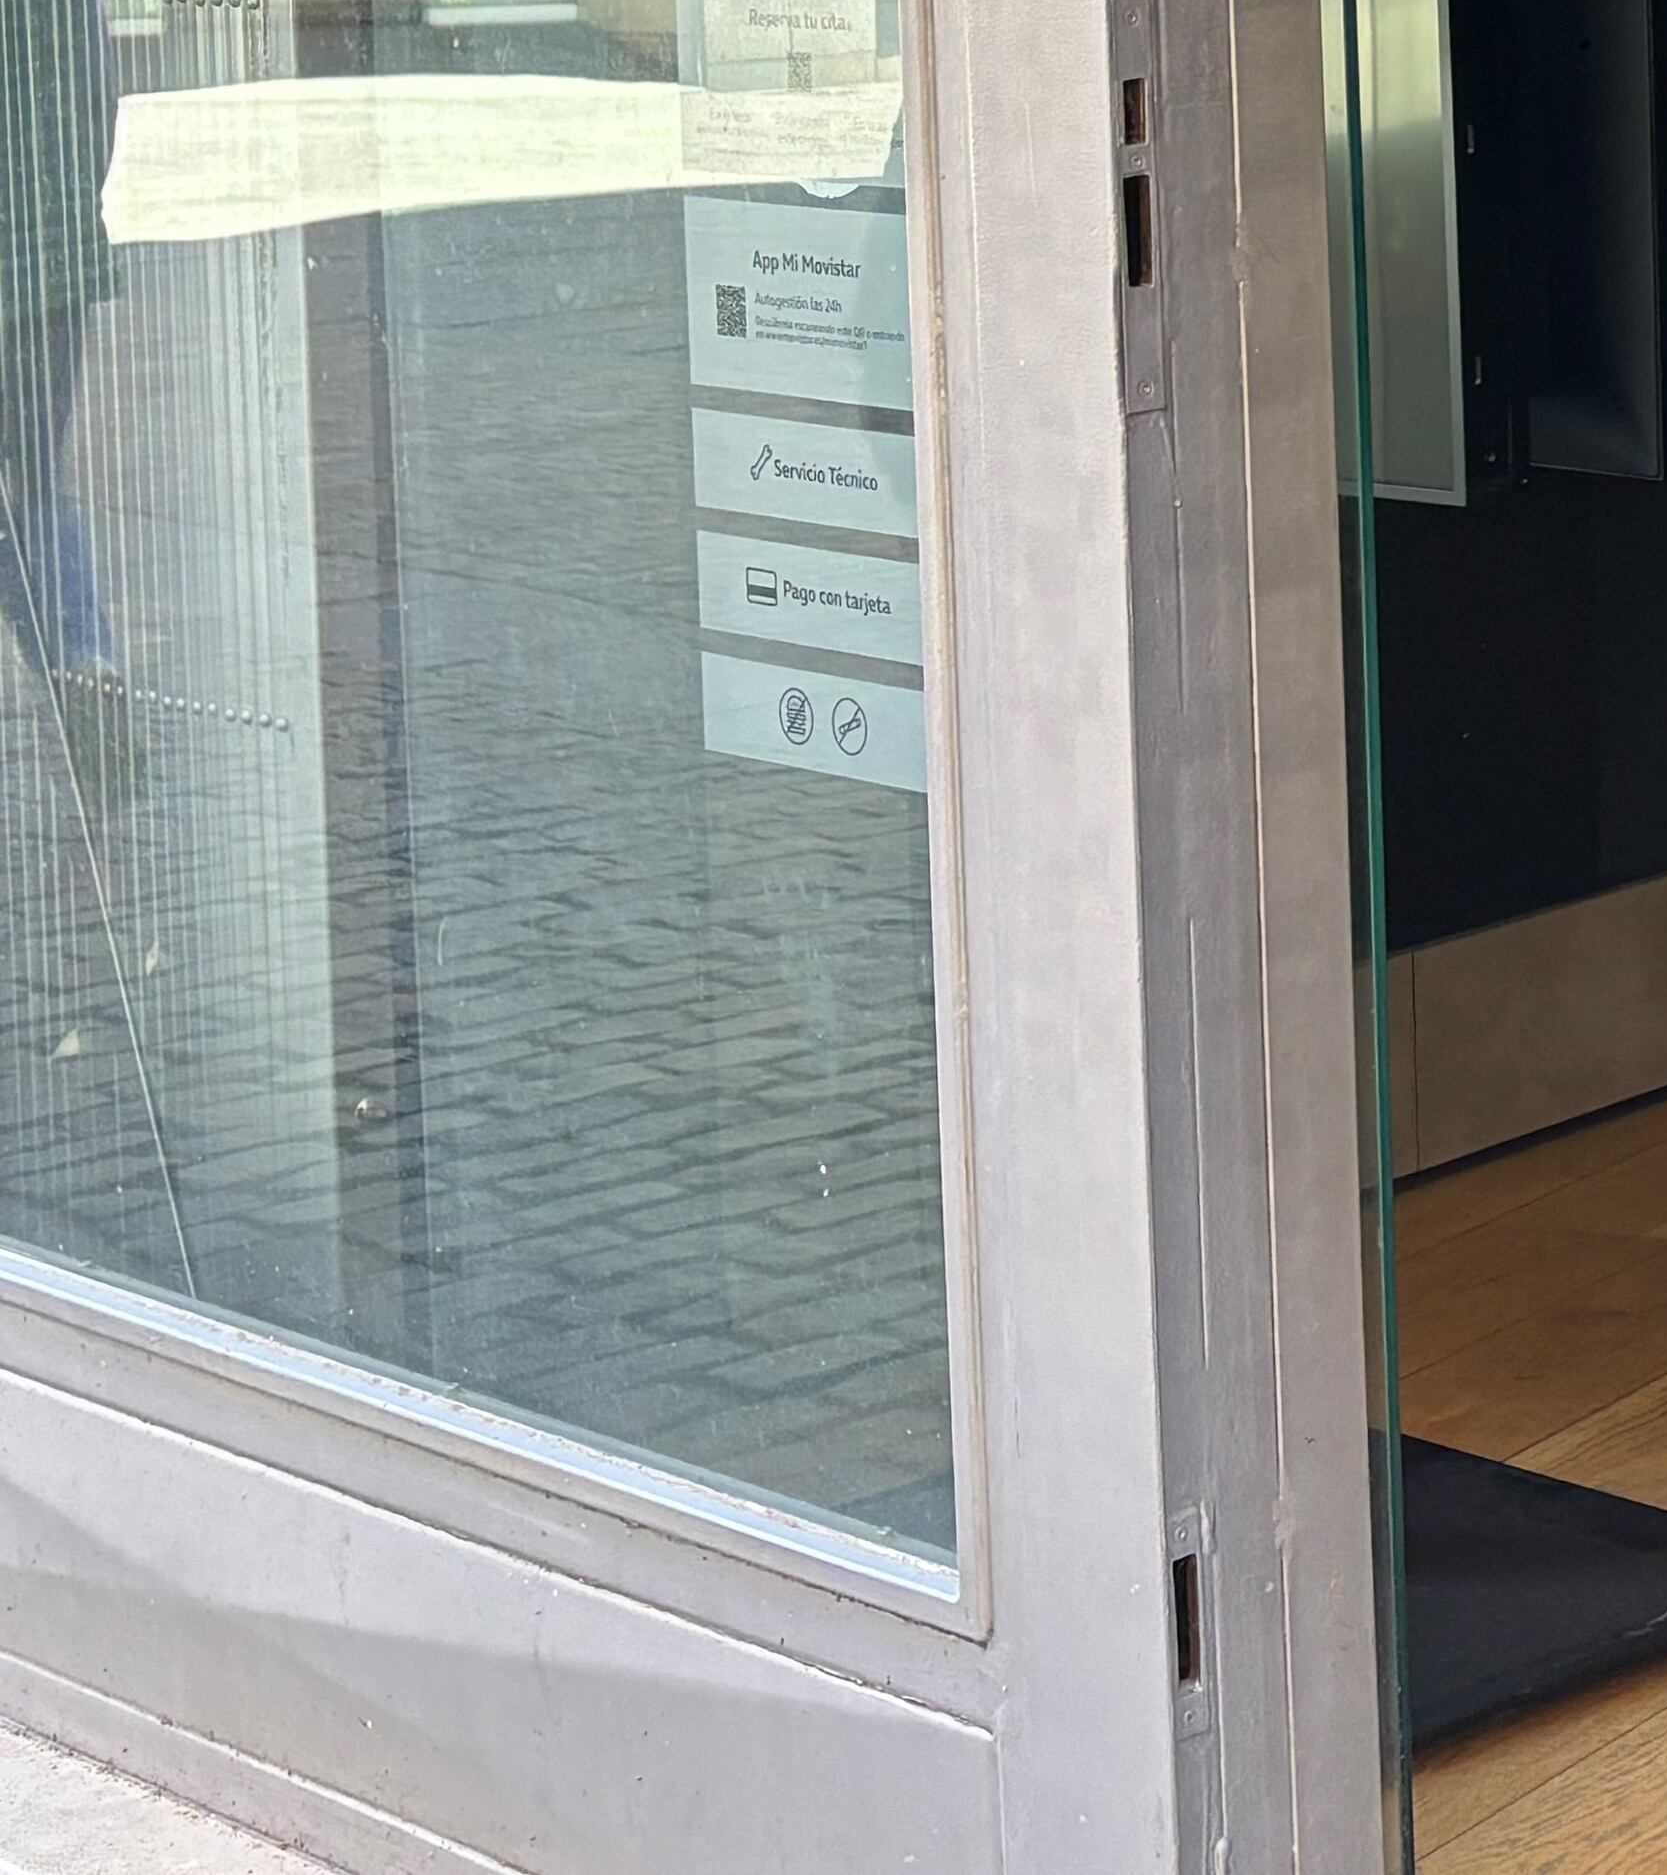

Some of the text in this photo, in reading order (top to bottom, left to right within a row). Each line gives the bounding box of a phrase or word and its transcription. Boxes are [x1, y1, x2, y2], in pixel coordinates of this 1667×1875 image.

[804, 11, 818, 30] tu
[753, 250, 861, 279] App Mi Movistar
[754, 291, 842, 313] Autogestión las 24h
[774, 459, 879, 492] Servicio Técnico
[783, 580, 892, 615] Pago con tarjeta
